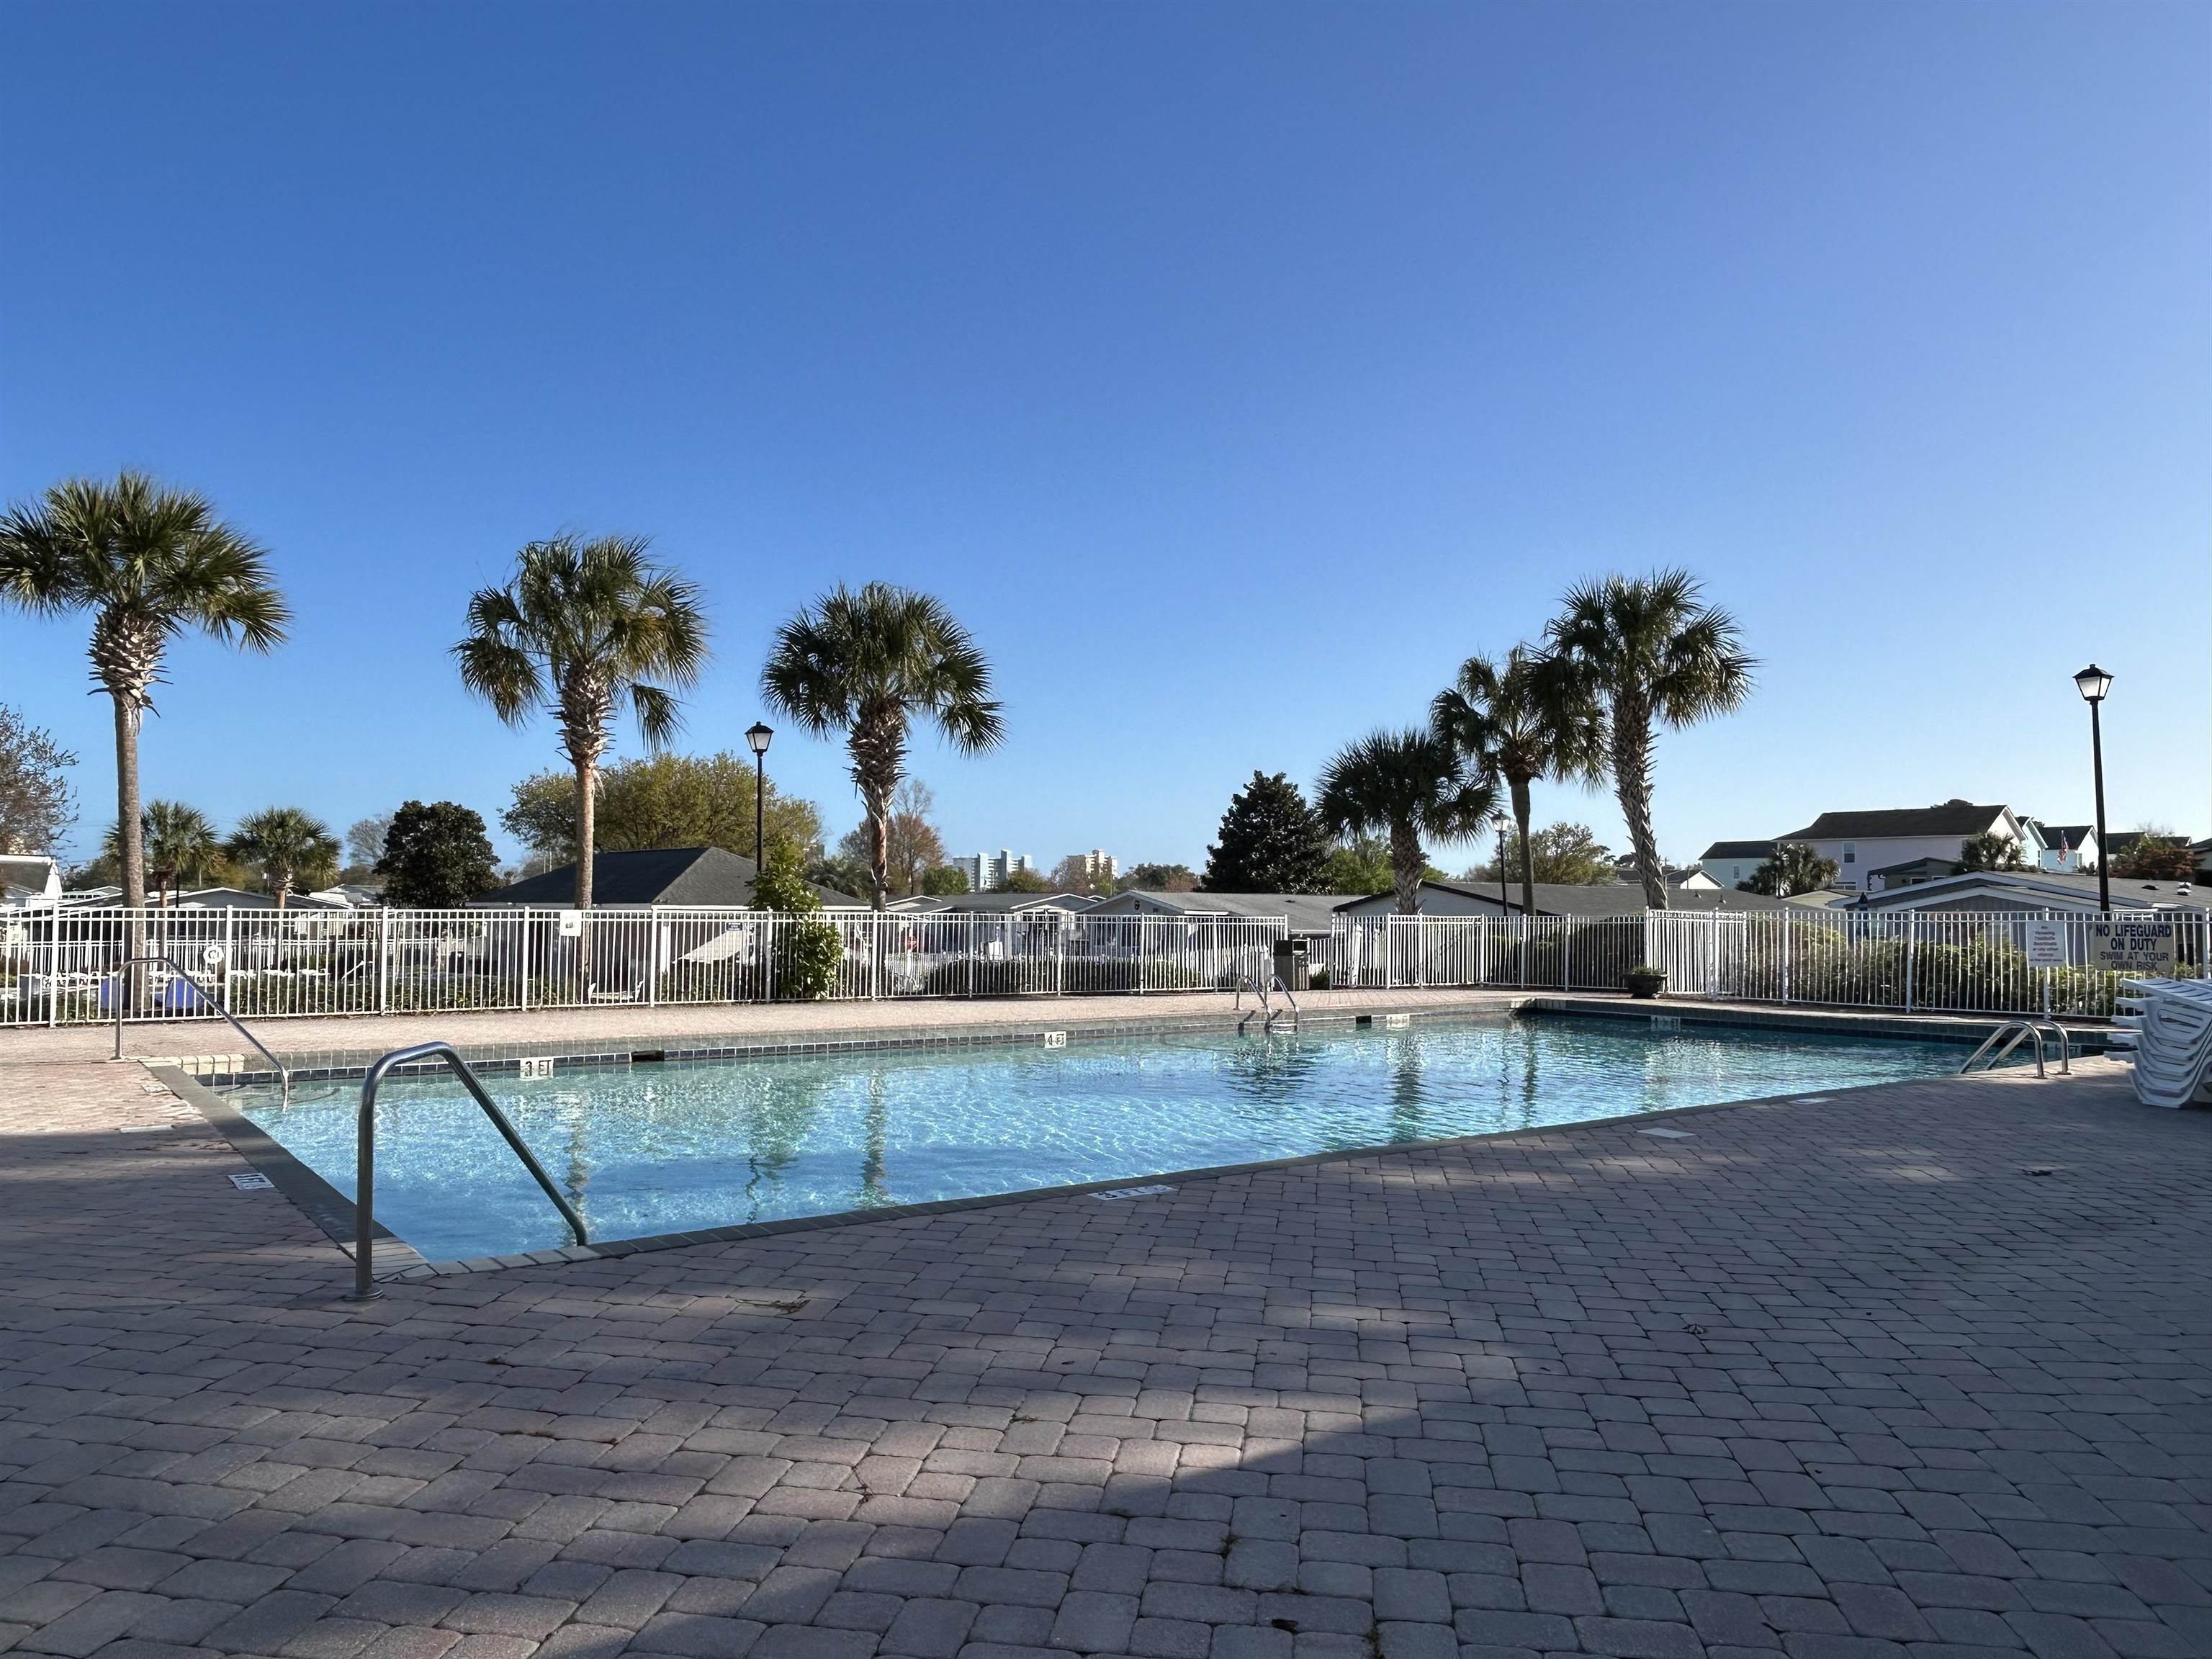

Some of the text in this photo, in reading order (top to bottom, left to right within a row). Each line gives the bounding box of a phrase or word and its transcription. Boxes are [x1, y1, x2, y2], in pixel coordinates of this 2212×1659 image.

[2095, 924, 2172, 938] NO LIFEGUARD
[2110, 938, 2157, 950] ON DUTY
[2100, 951, 2169, 961] SWIM AT YOUR
[2110, 961, 2158, 971] OWN RISK
